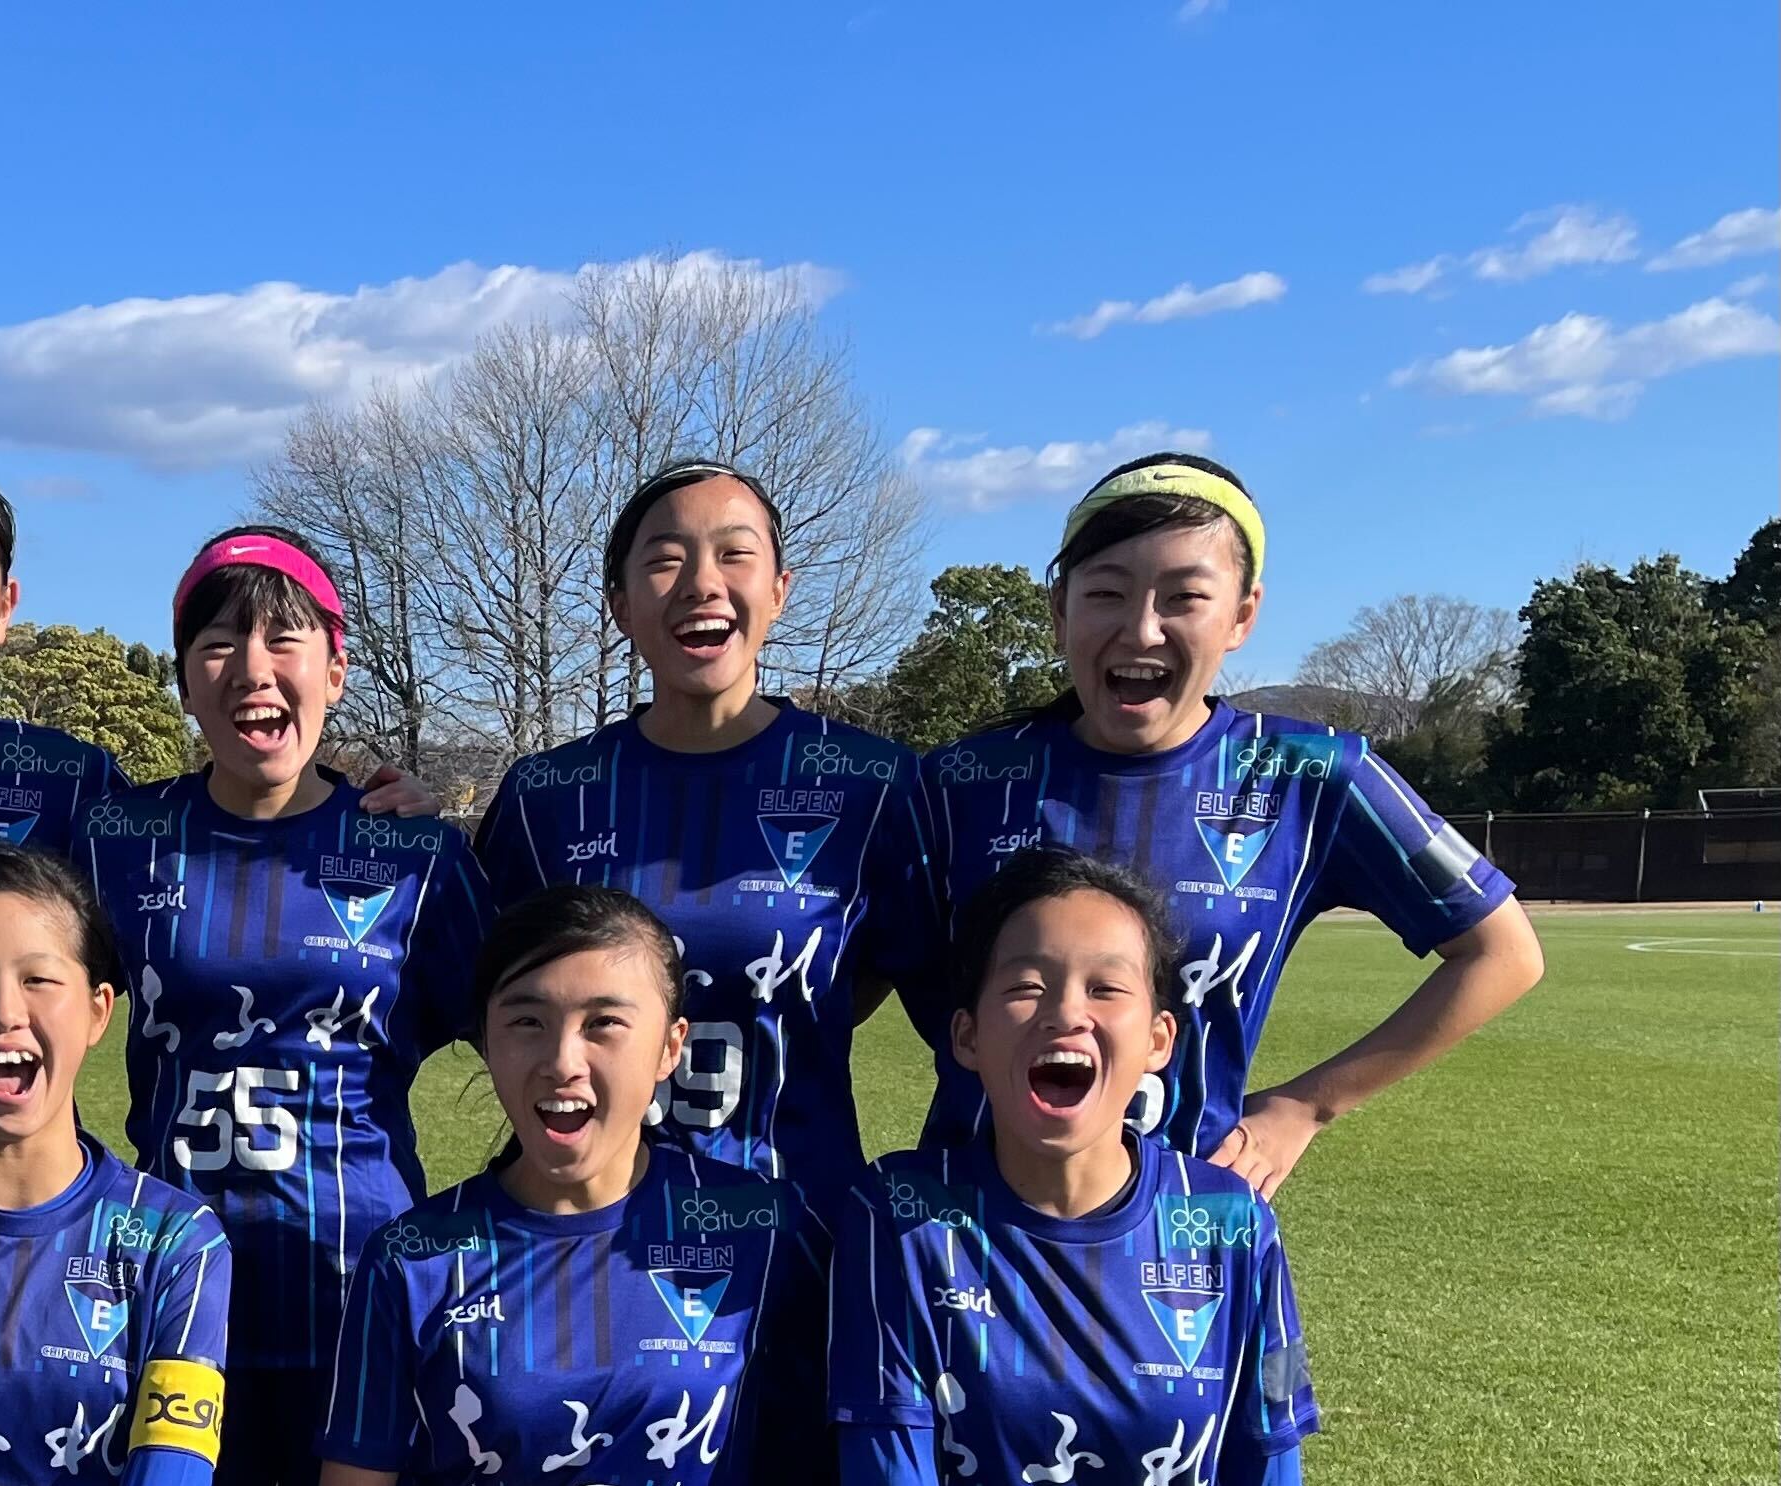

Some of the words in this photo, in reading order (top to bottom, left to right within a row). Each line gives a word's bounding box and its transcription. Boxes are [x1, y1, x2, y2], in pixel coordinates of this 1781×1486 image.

[3, 735, 35, 759] do
[803, 736, 840, 757] do
[939, 745, 976, 767] do
[1236, 739, 1273, 765] do
[1, 753, 85, 778] natural
[515, 757, 603, 795] natural
[800, 755, 899, 783] natural
[939, 755, 1033, 782] natural
[1236, 749, 1335, 781] natural
[89, 793, 123, 819] do
[758, 789, 844, 814] ELFEN
[1195, 792, 1280, 817] ELFEN
[87, 809, 172, 837] natural
[356, 814, 391, 832] do
[355, 829, 443, 853] natural
[320, 855, 398, 883] ELFEN
[174, 1066, 299, 1172] 55
[681, 1190, 718, 1215] do
[683, 1198, 779, 1232] natural
[1170, 1200, 1209, 1228] do
[109, 1209, 143, 1232] do
[383, 1219, 420, 1240] do
[386, 1226, 480, 1256] natural
[648, 1244, 734, 1269] ELFEN
[1141, 1261, 1224, 1289] ELFEN
